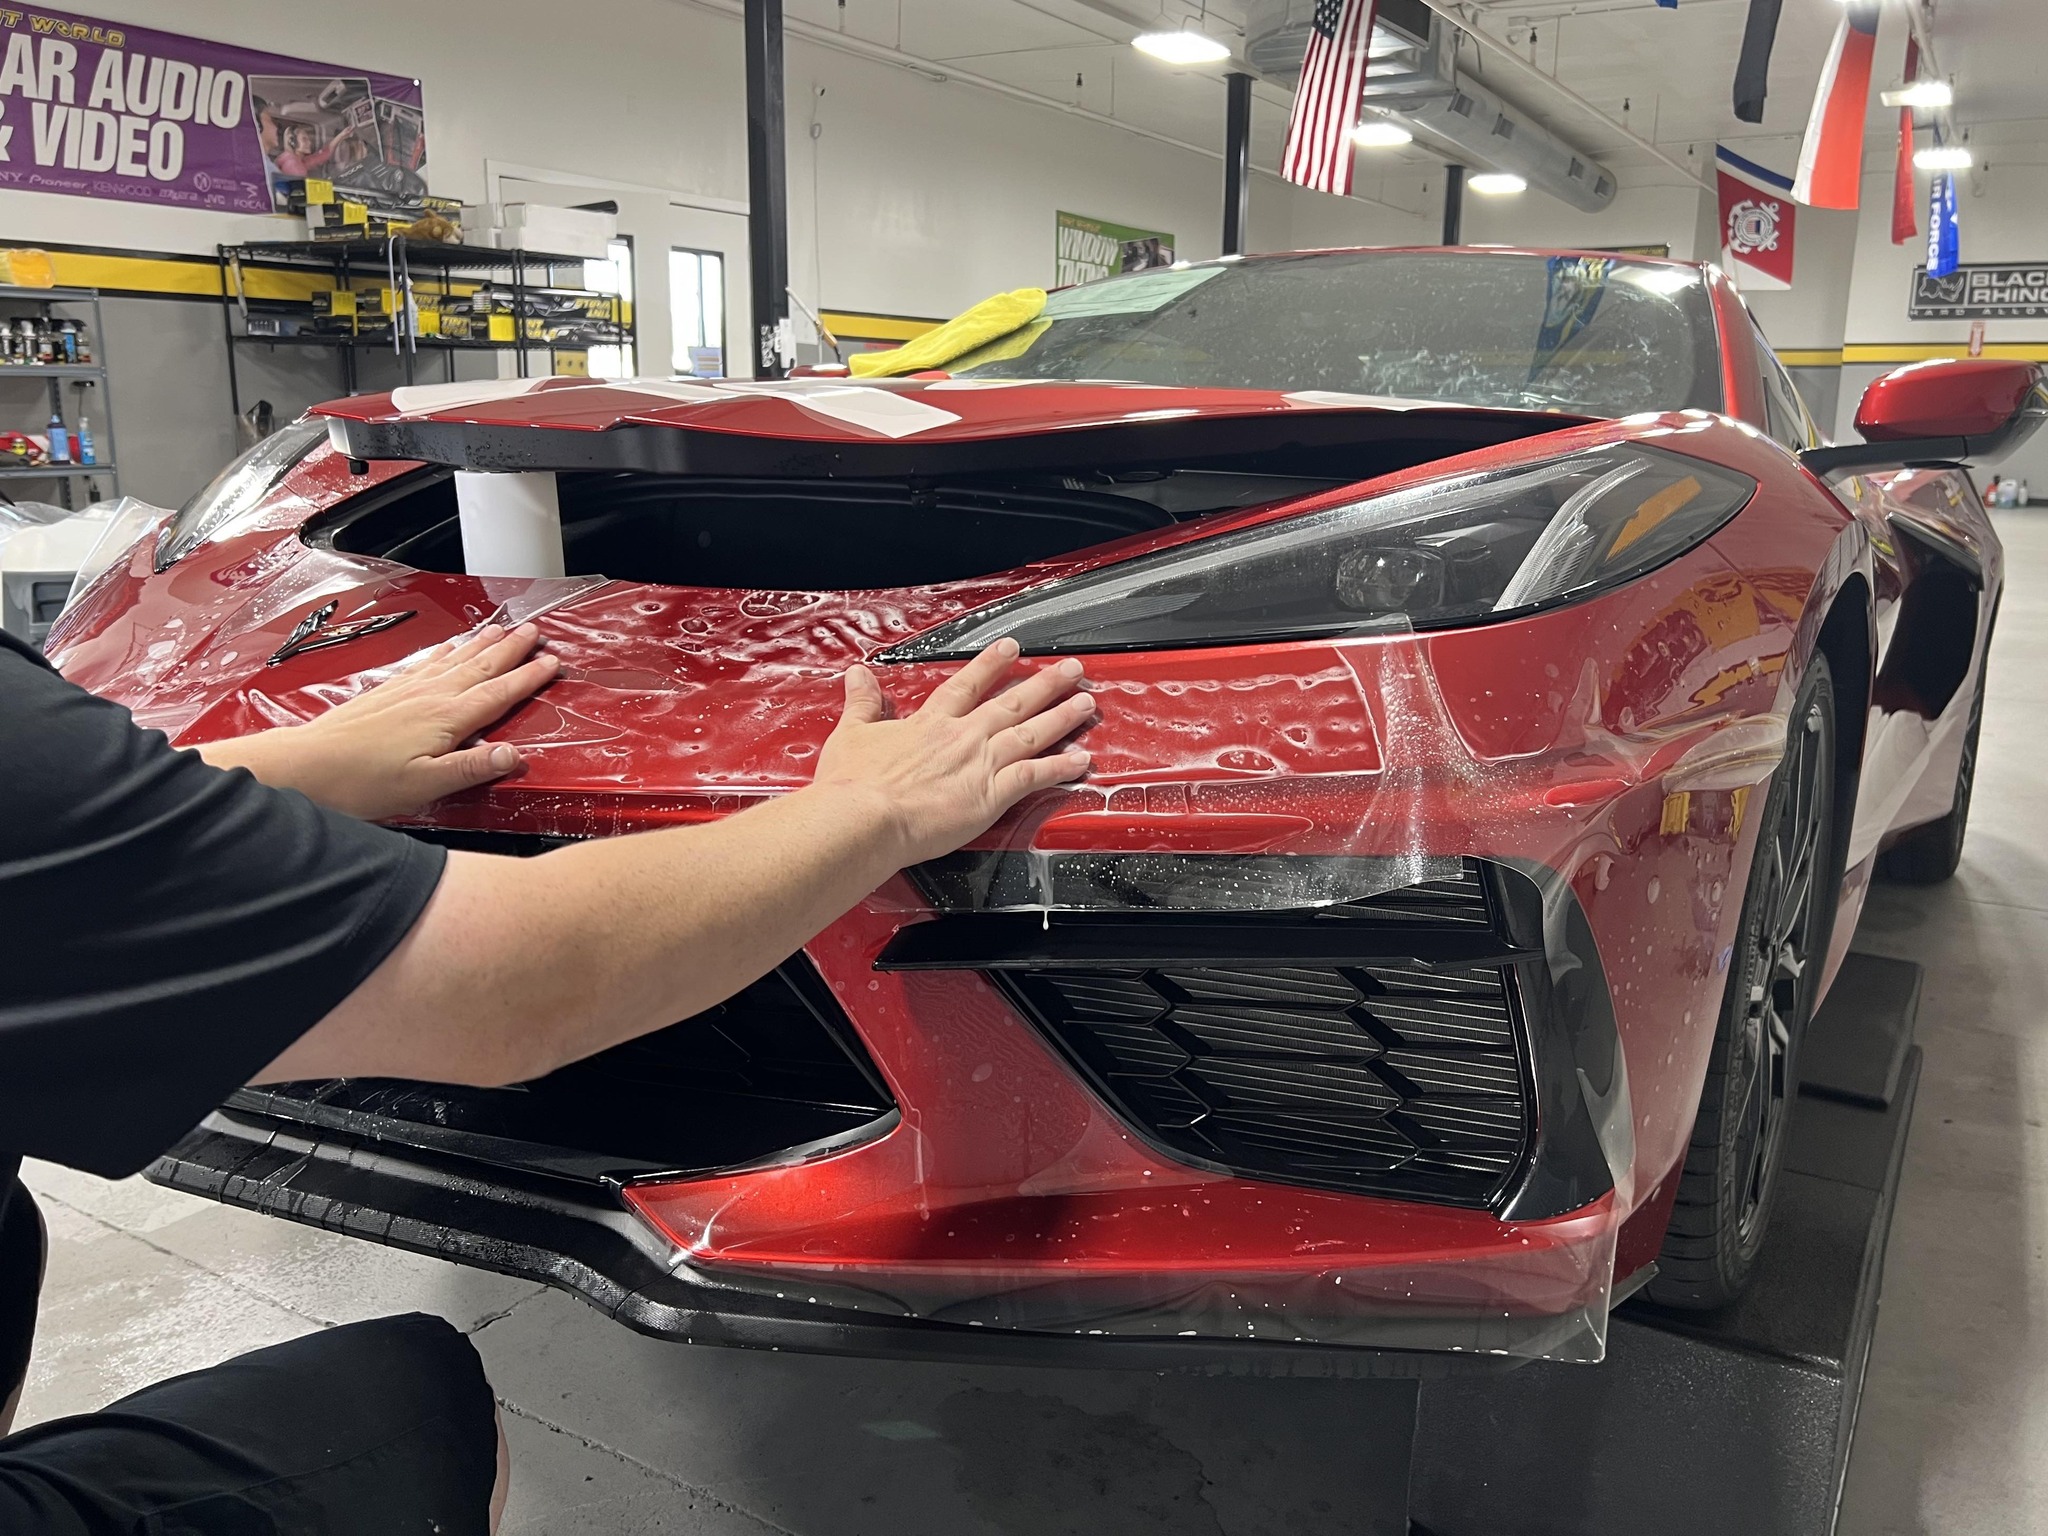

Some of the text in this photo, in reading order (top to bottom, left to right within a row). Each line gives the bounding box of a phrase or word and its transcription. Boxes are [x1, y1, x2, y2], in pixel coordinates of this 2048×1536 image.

[28, 14, 125, 47] WORLD
[88, 48, 245, 129] AUDIO
[32, 101, 184, 181] VIDEO
[28, 174, 88, 189] Pioneer
[93, 180, 153, 197] KENWOOD
[233, 198, 267, 210] FOCAL
[1058, 226, 1119, 266] WINDOW
[1926, 201, 1942, 271] FORCE
[1972, 271, 2048, 287] BLAC
